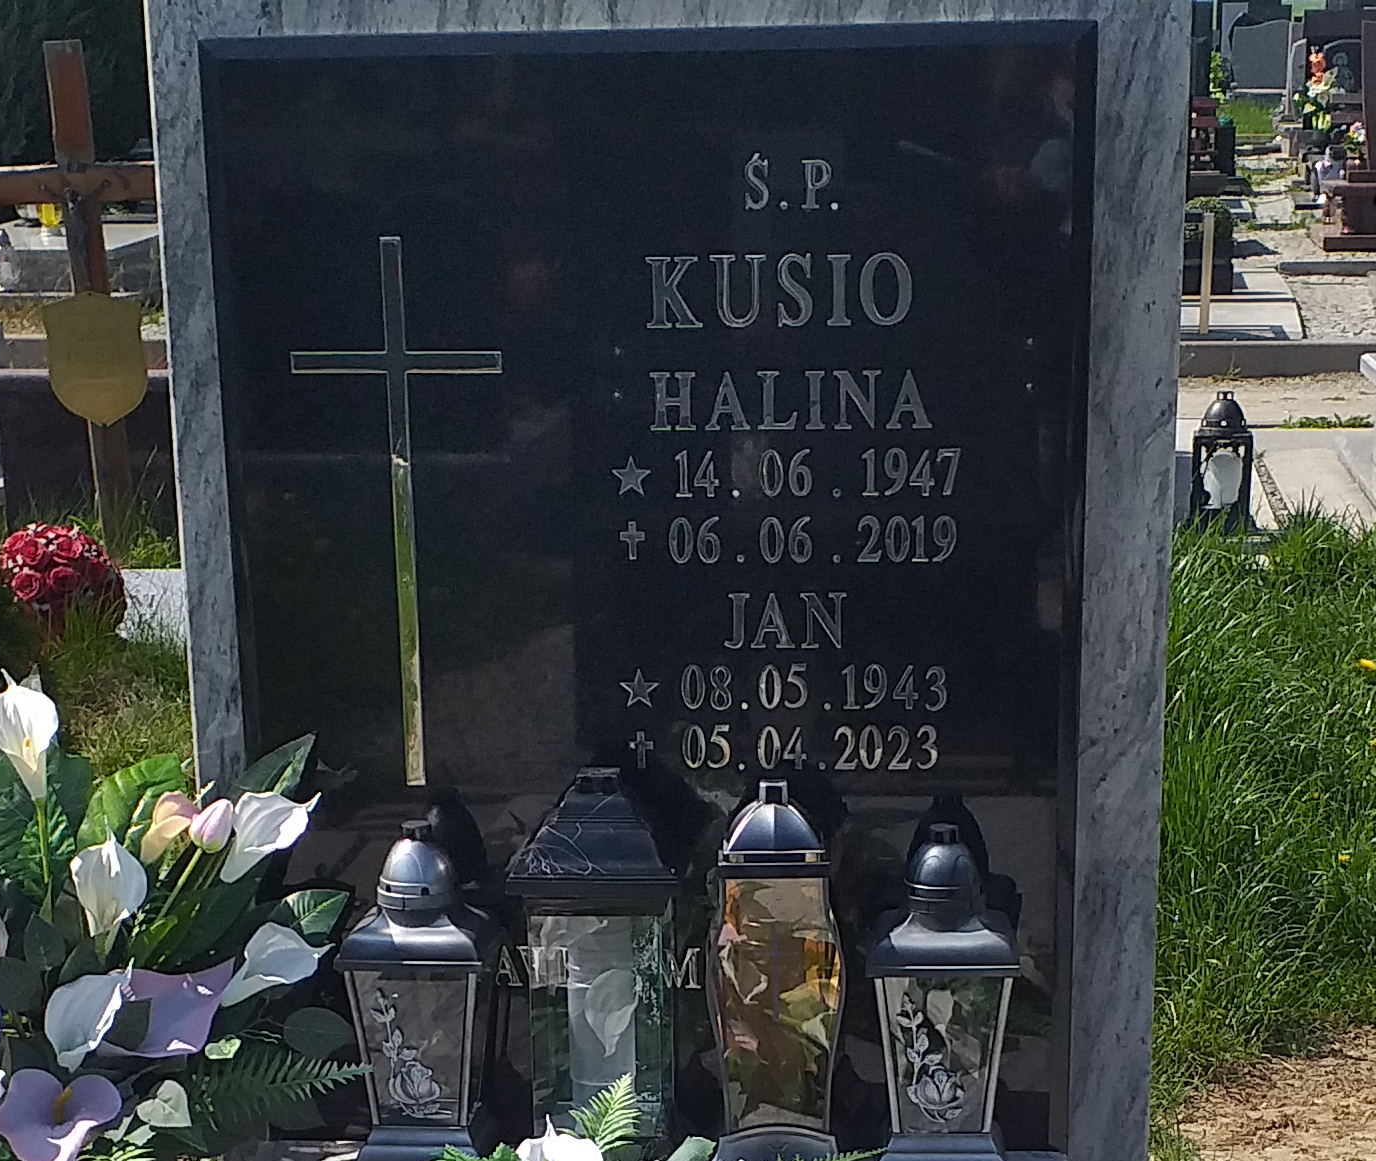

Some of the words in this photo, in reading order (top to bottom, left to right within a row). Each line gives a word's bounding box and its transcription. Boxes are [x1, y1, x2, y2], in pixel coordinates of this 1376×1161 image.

[645, 252, 913, 329] KUSIO
[649, 370, 933, 431] HALINA
[724, 592, 848, 649] JAN
